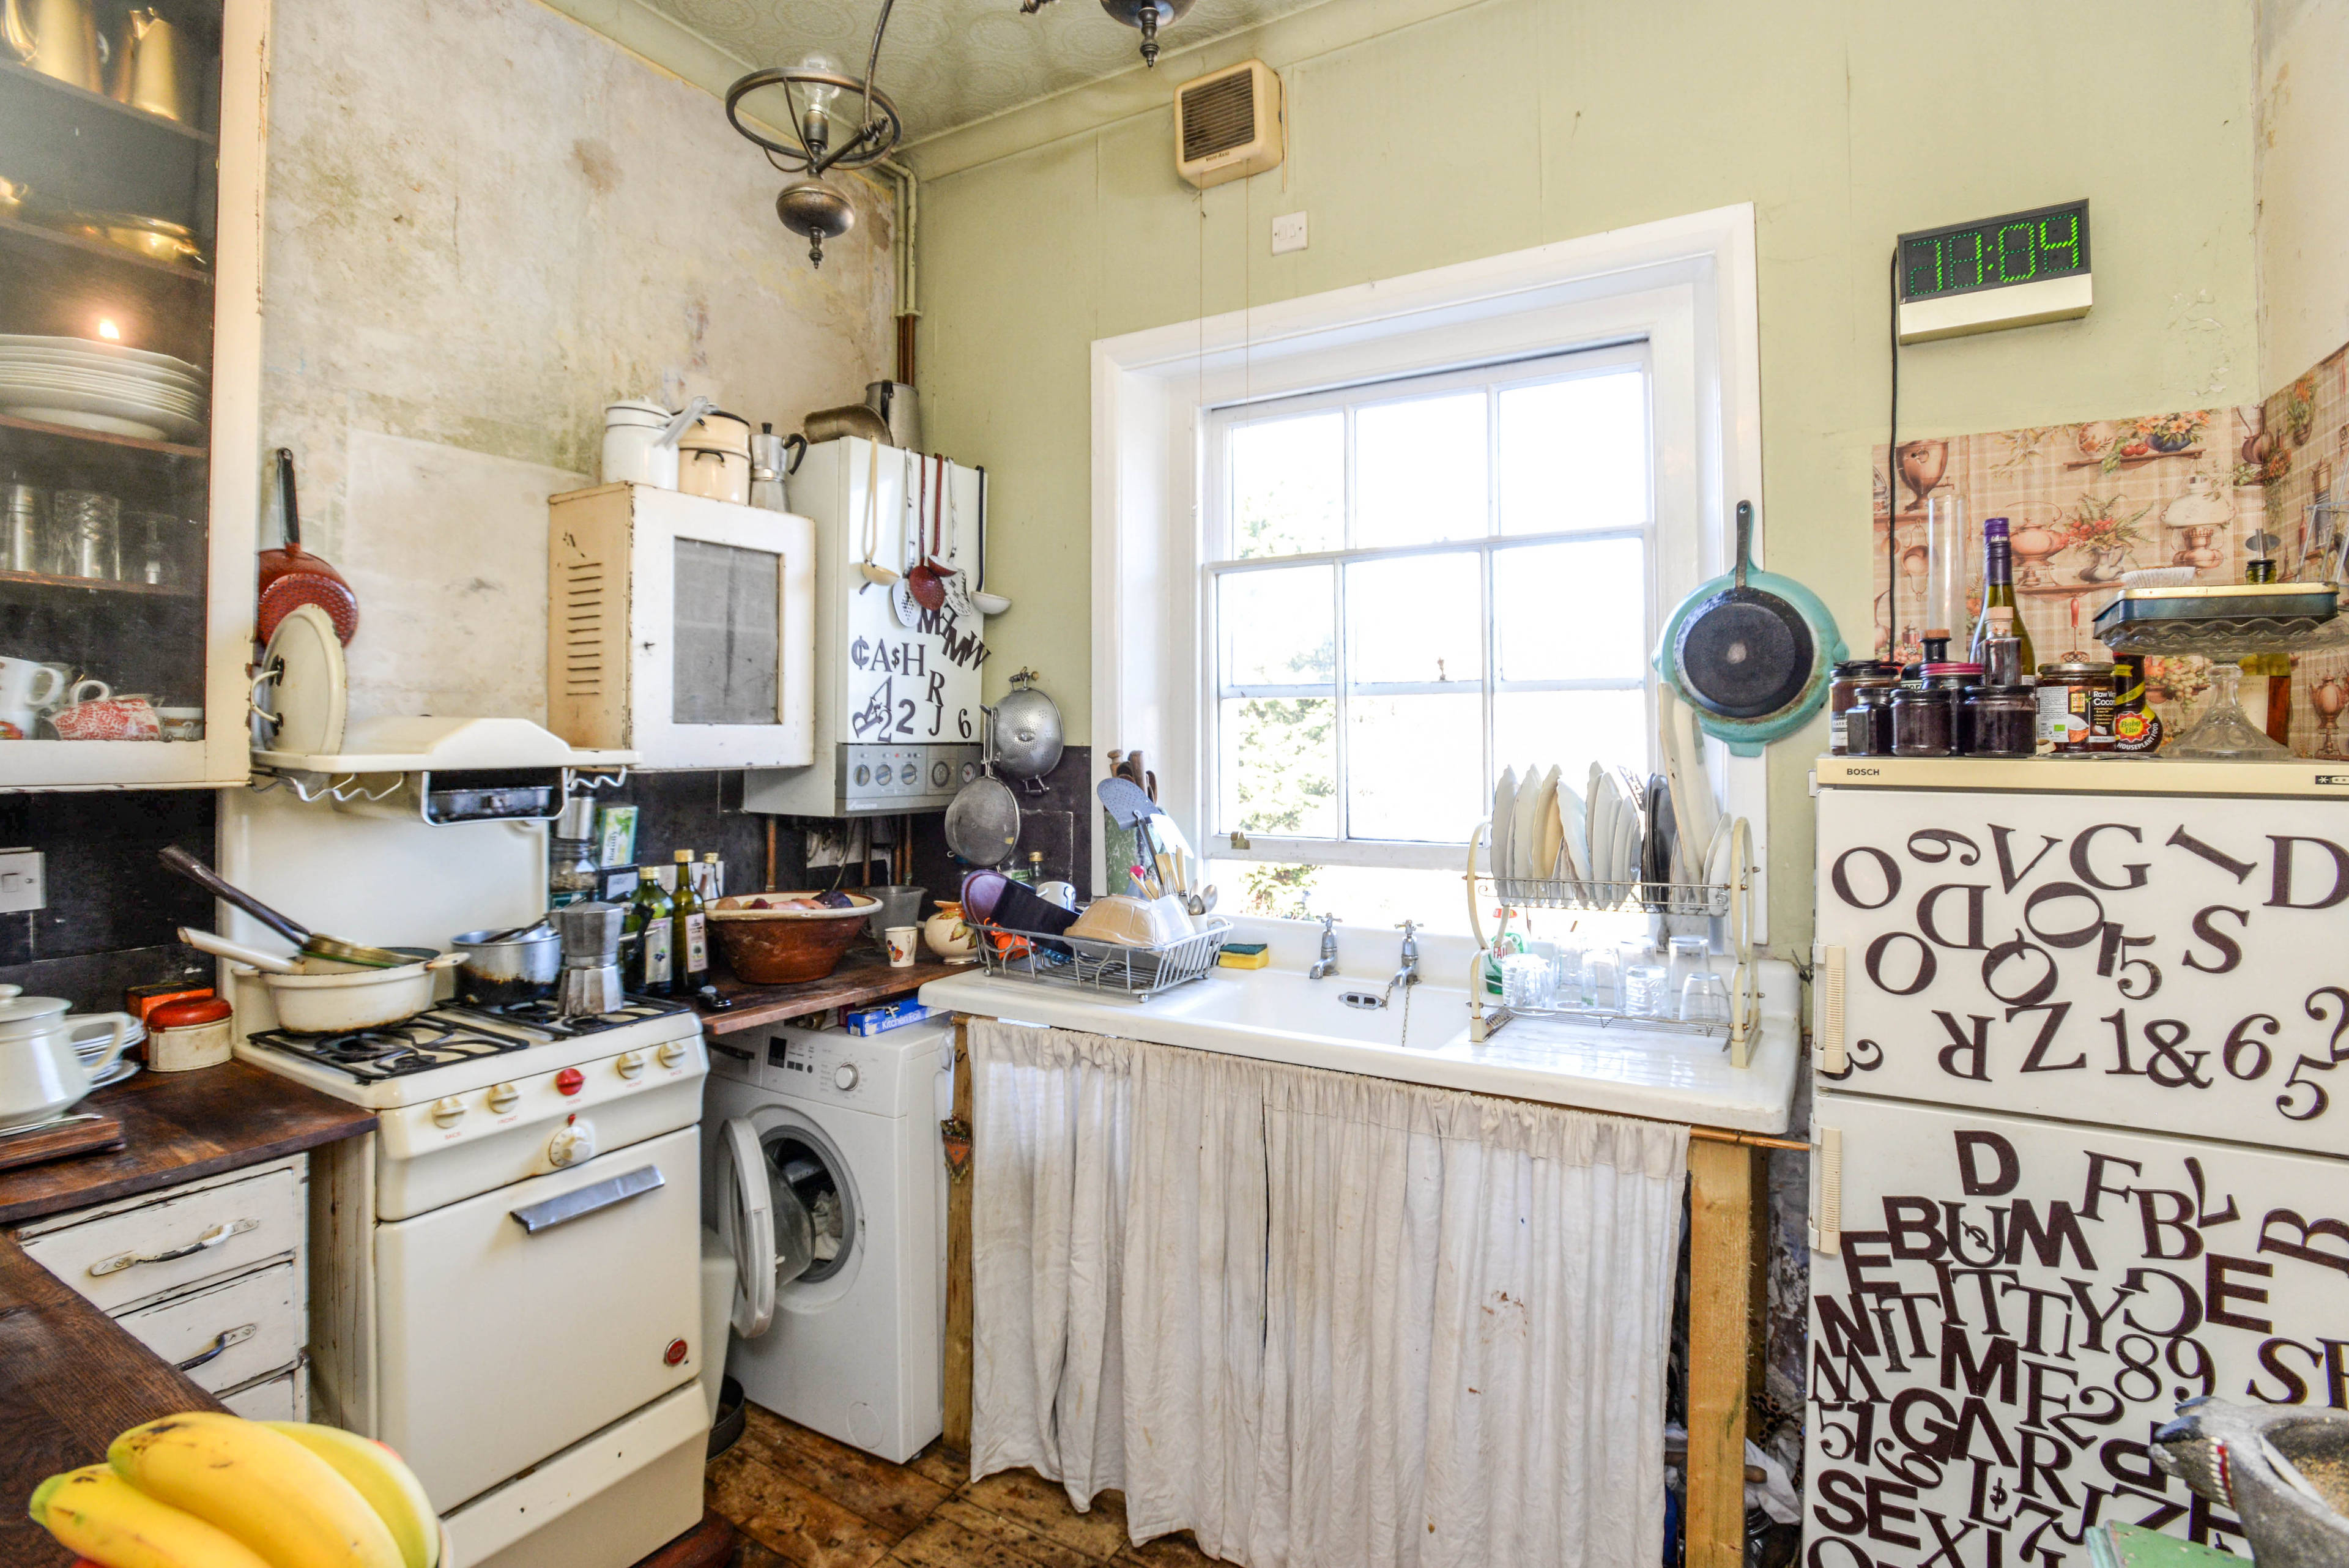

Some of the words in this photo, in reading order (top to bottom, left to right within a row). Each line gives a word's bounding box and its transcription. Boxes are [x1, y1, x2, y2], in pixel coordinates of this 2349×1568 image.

[896, 699, 916, 735] 2
[925, 670, 944, 707] R
[927, 705, 944, 737] J
[958, 708, 971, 739] 6
[2117, 737, 2154, 750] HOUSEPLANT
[2150, 723, 2159, 737] FOOD
[2121, 719, 2141, 729] Baby
[2069, 823, 2152, 891] G
[2262, 834, 2349, 910] D
[1493, 946, 1508, 959] FAI
[2181, 904, 2251, 975] S
[881, 1016, 908, 1030] Kitchen
[909, 1010, 921, 1024] Foil
[2005, 1001, 2088, 1074] Z
[2222, 1013, 2280, 1082] 6
[497, 1115, 519, 1125] FRONT
[2275, 1053, 2338, 1121] 5
[445, 1132, 461, 1140] BACK
[1953, 1130, 2020, 1196] D
[2074, 1150, 2142, 1222] F
[2129, 1188, 2204, 1260] B
[2205, 1252, 2274, 1335] E
[2113, 1333, 2162, 1403] 8
[2245, 1337, 2324, 1405] S
[2011, 1426, 2082, 1510] R
